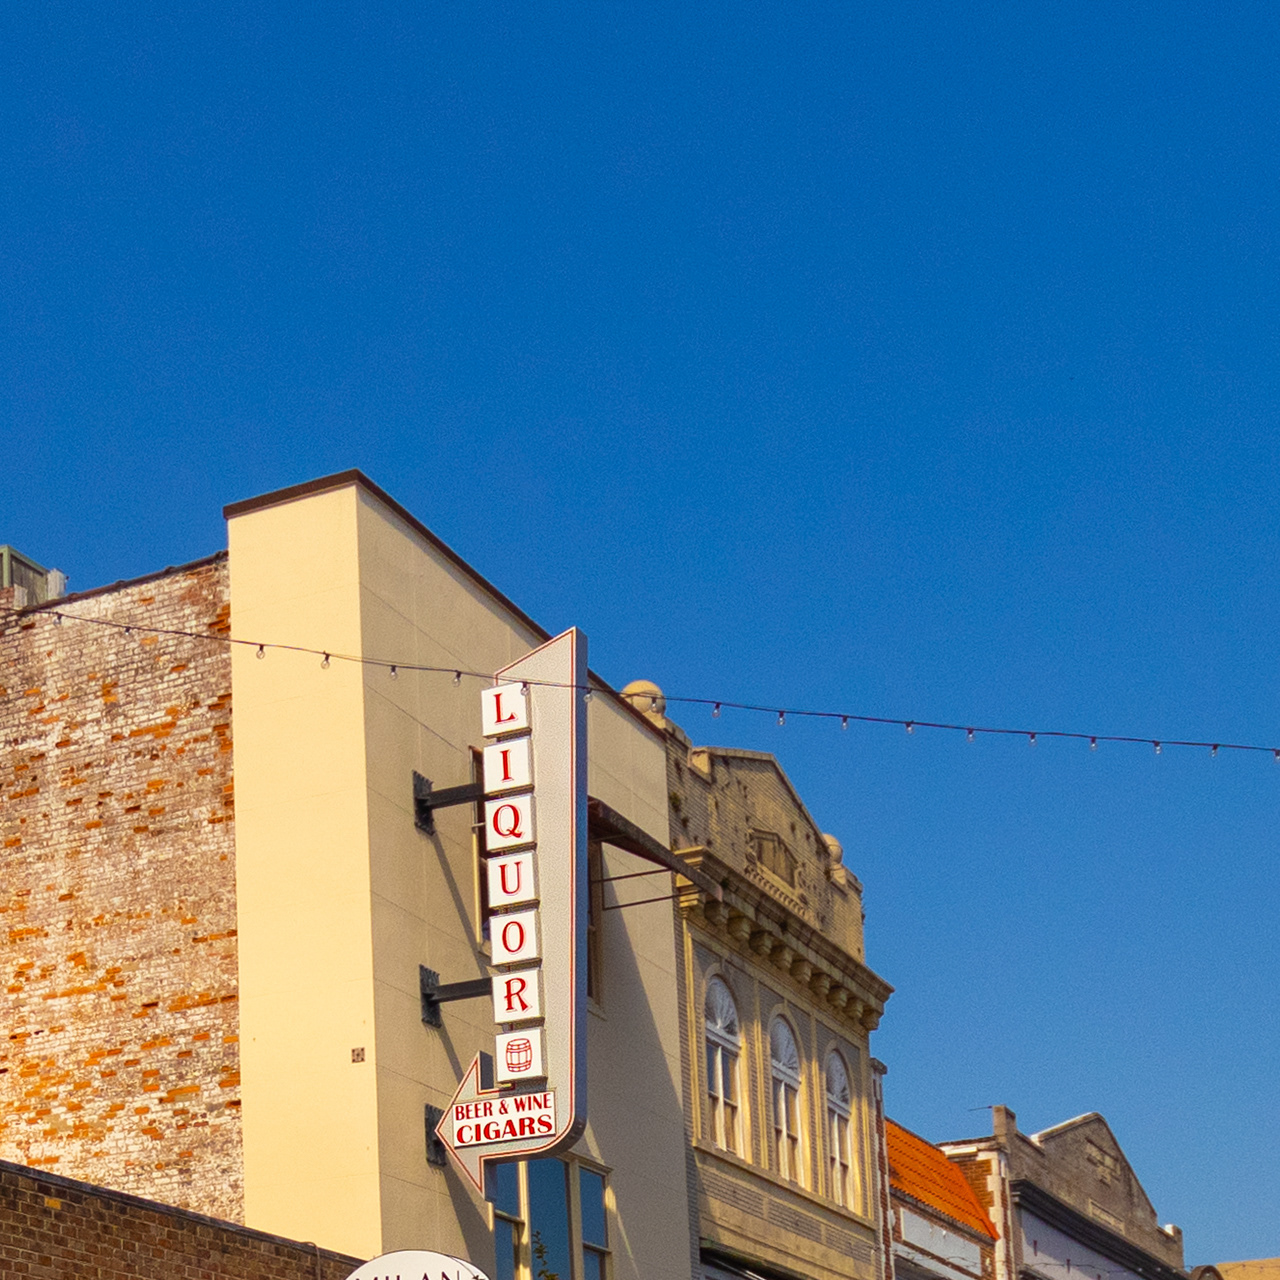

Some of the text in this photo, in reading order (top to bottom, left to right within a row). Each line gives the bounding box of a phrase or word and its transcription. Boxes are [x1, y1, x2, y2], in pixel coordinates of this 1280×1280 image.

[492, 691, 531, 1013] LIQUOR
[455, 1093, 552, 1121] BEER & WINE
[456, 1114, 553, 1144] CIGARS
